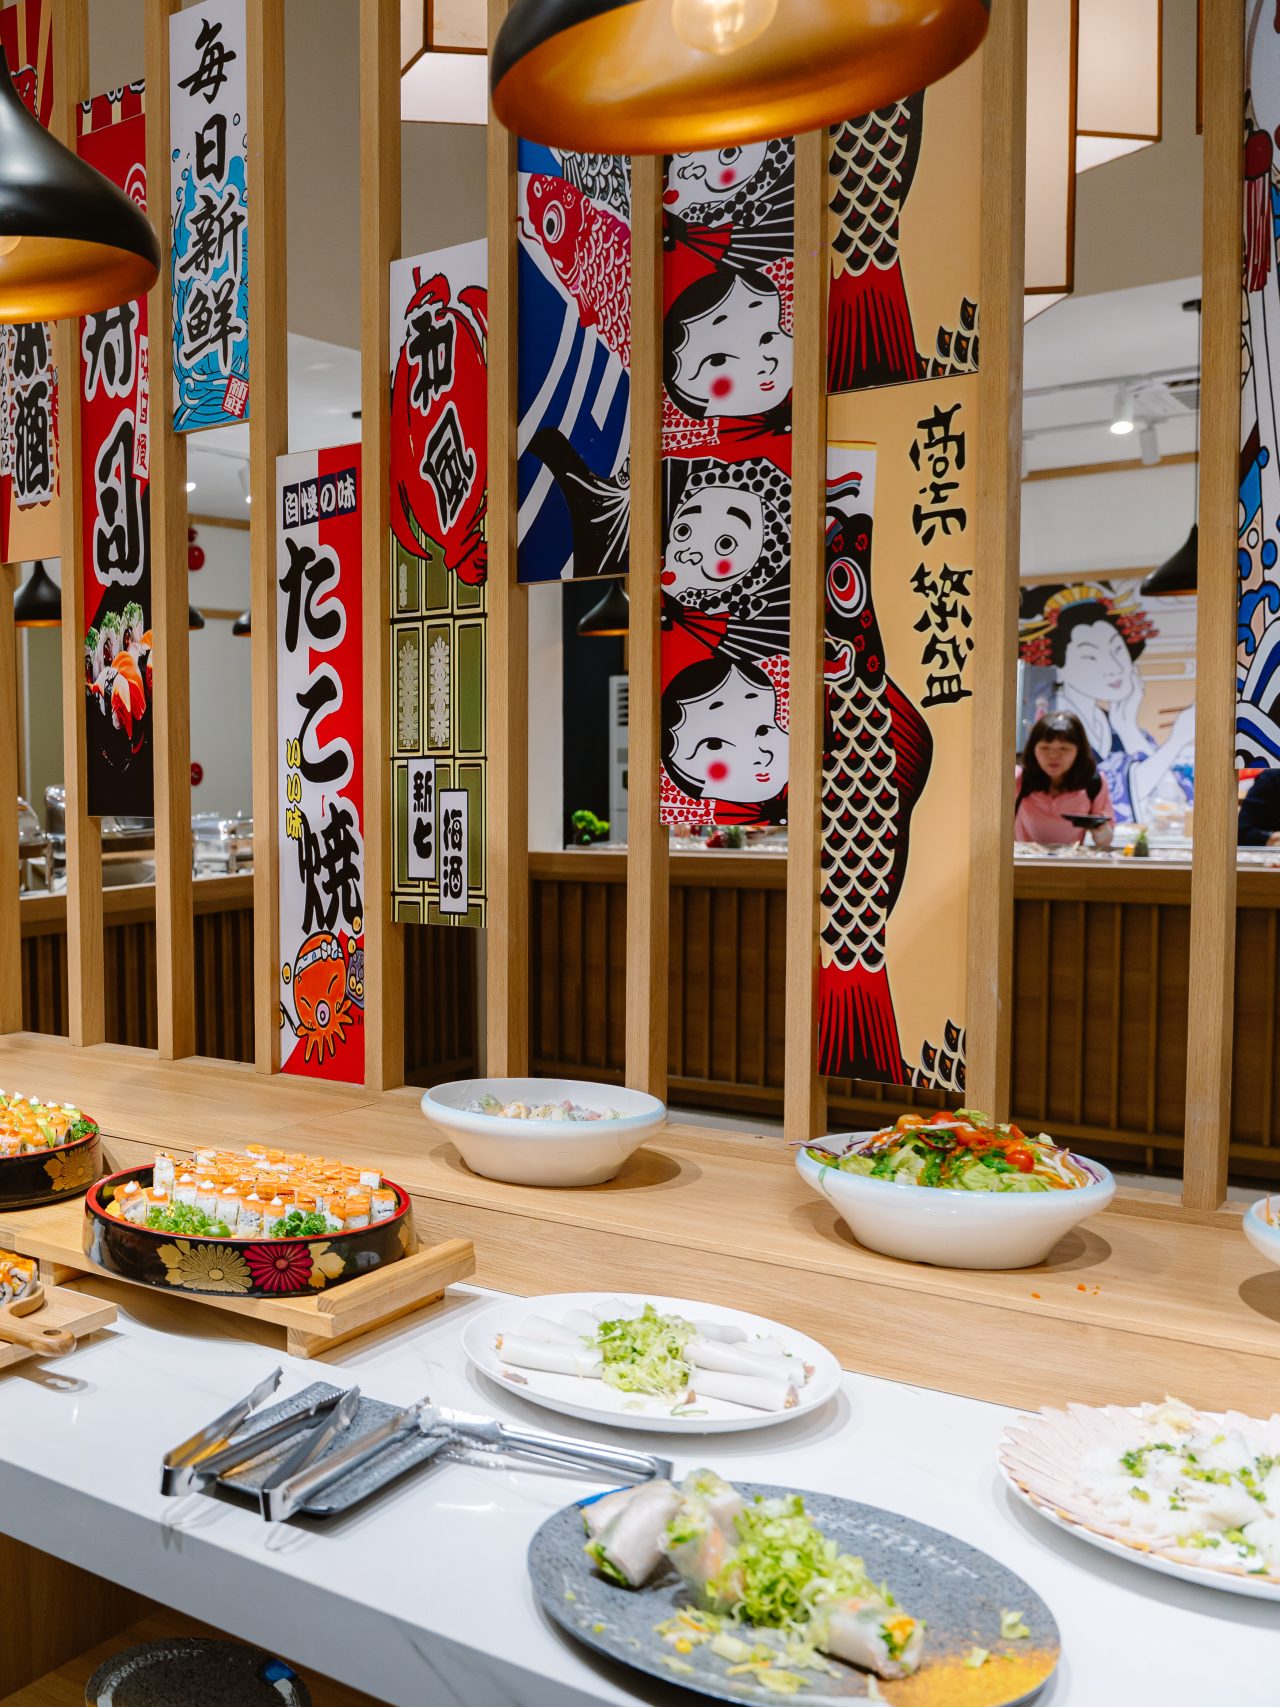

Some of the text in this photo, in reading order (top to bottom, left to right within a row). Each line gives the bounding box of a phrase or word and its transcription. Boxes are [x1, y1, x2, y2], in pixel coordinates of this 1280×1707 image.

[285, 473, 356, 525] 自慢の味
[278, 537, 364, 935] たこ焼
[286, 738, 302, 840] いい味
[443, 808, 463, 899] 梅酒
